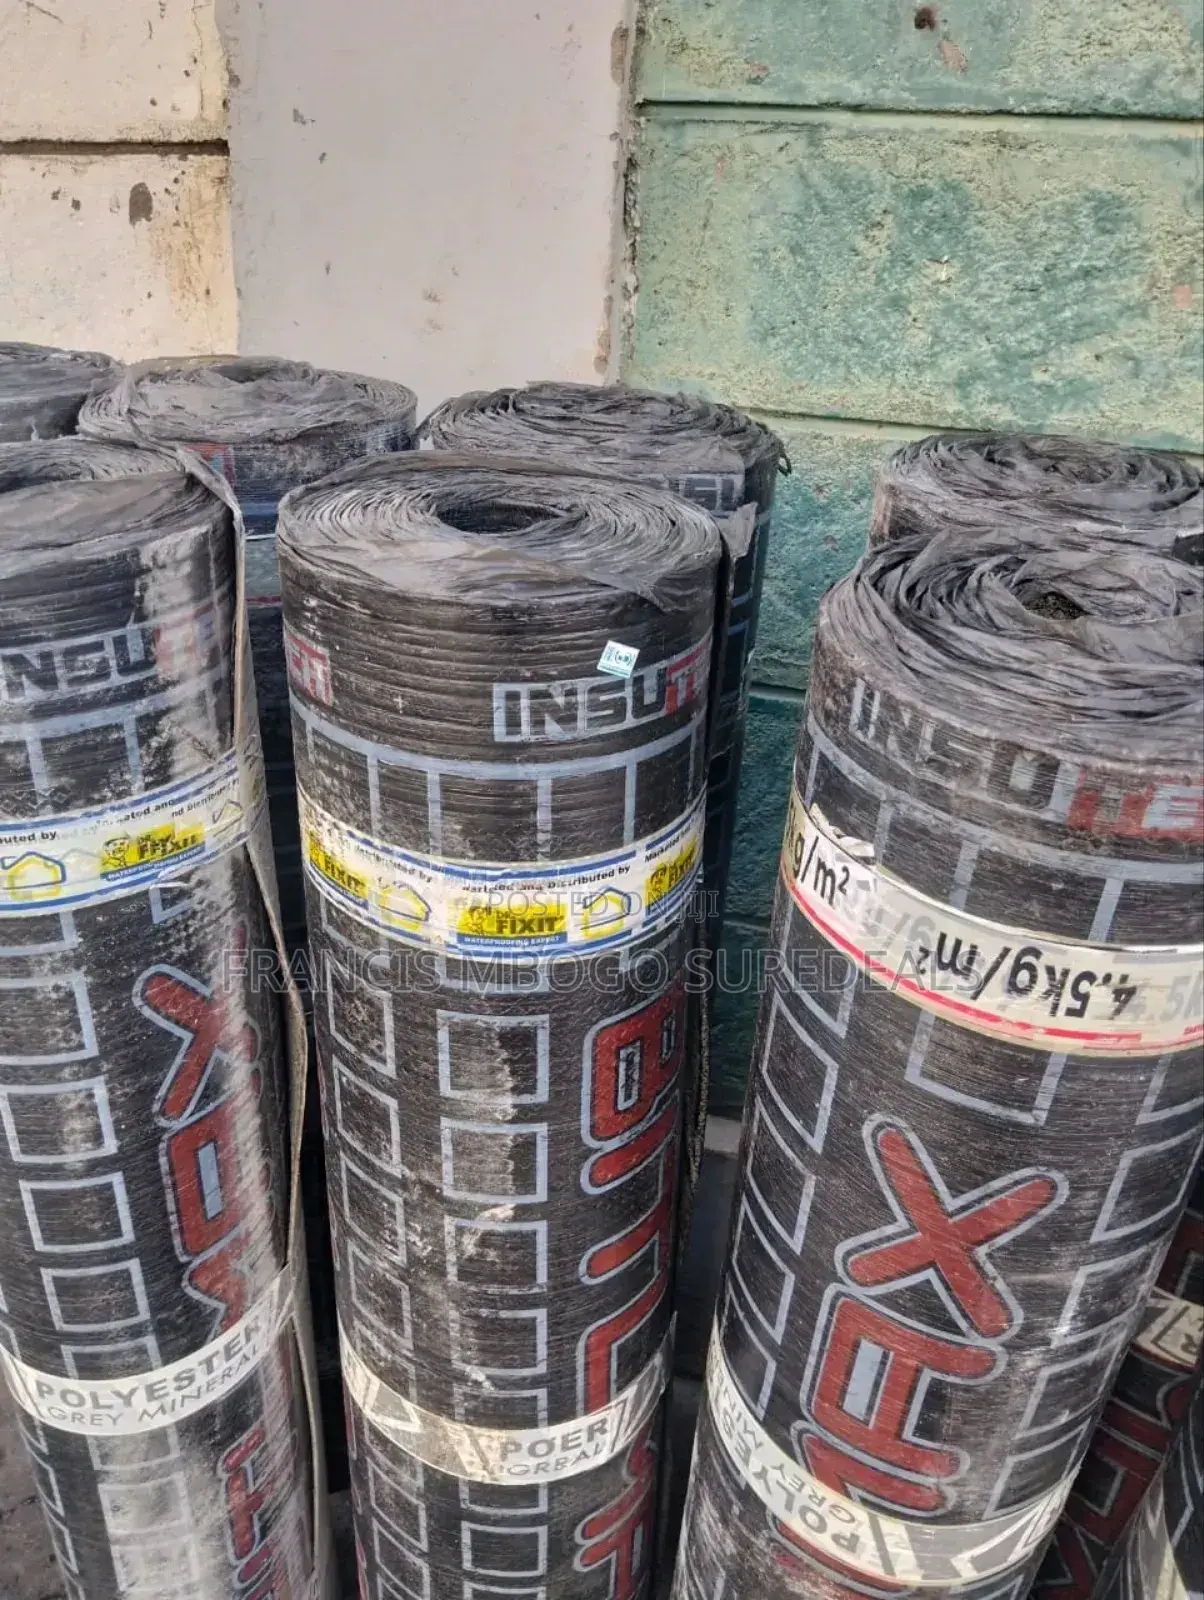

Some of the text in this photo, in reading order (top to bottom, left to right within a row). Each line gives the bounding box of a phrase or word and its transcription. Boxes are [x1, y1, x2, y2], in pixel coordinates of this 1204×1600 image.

[41, 830, 57, 841] by
[618, 864, 631, 875] by
[495, 916, 558, 935] FIXIT
[36, 1317, 261, 1410] POLYESTER
[48, 1348, 257, 1427] GREY MINERAL
